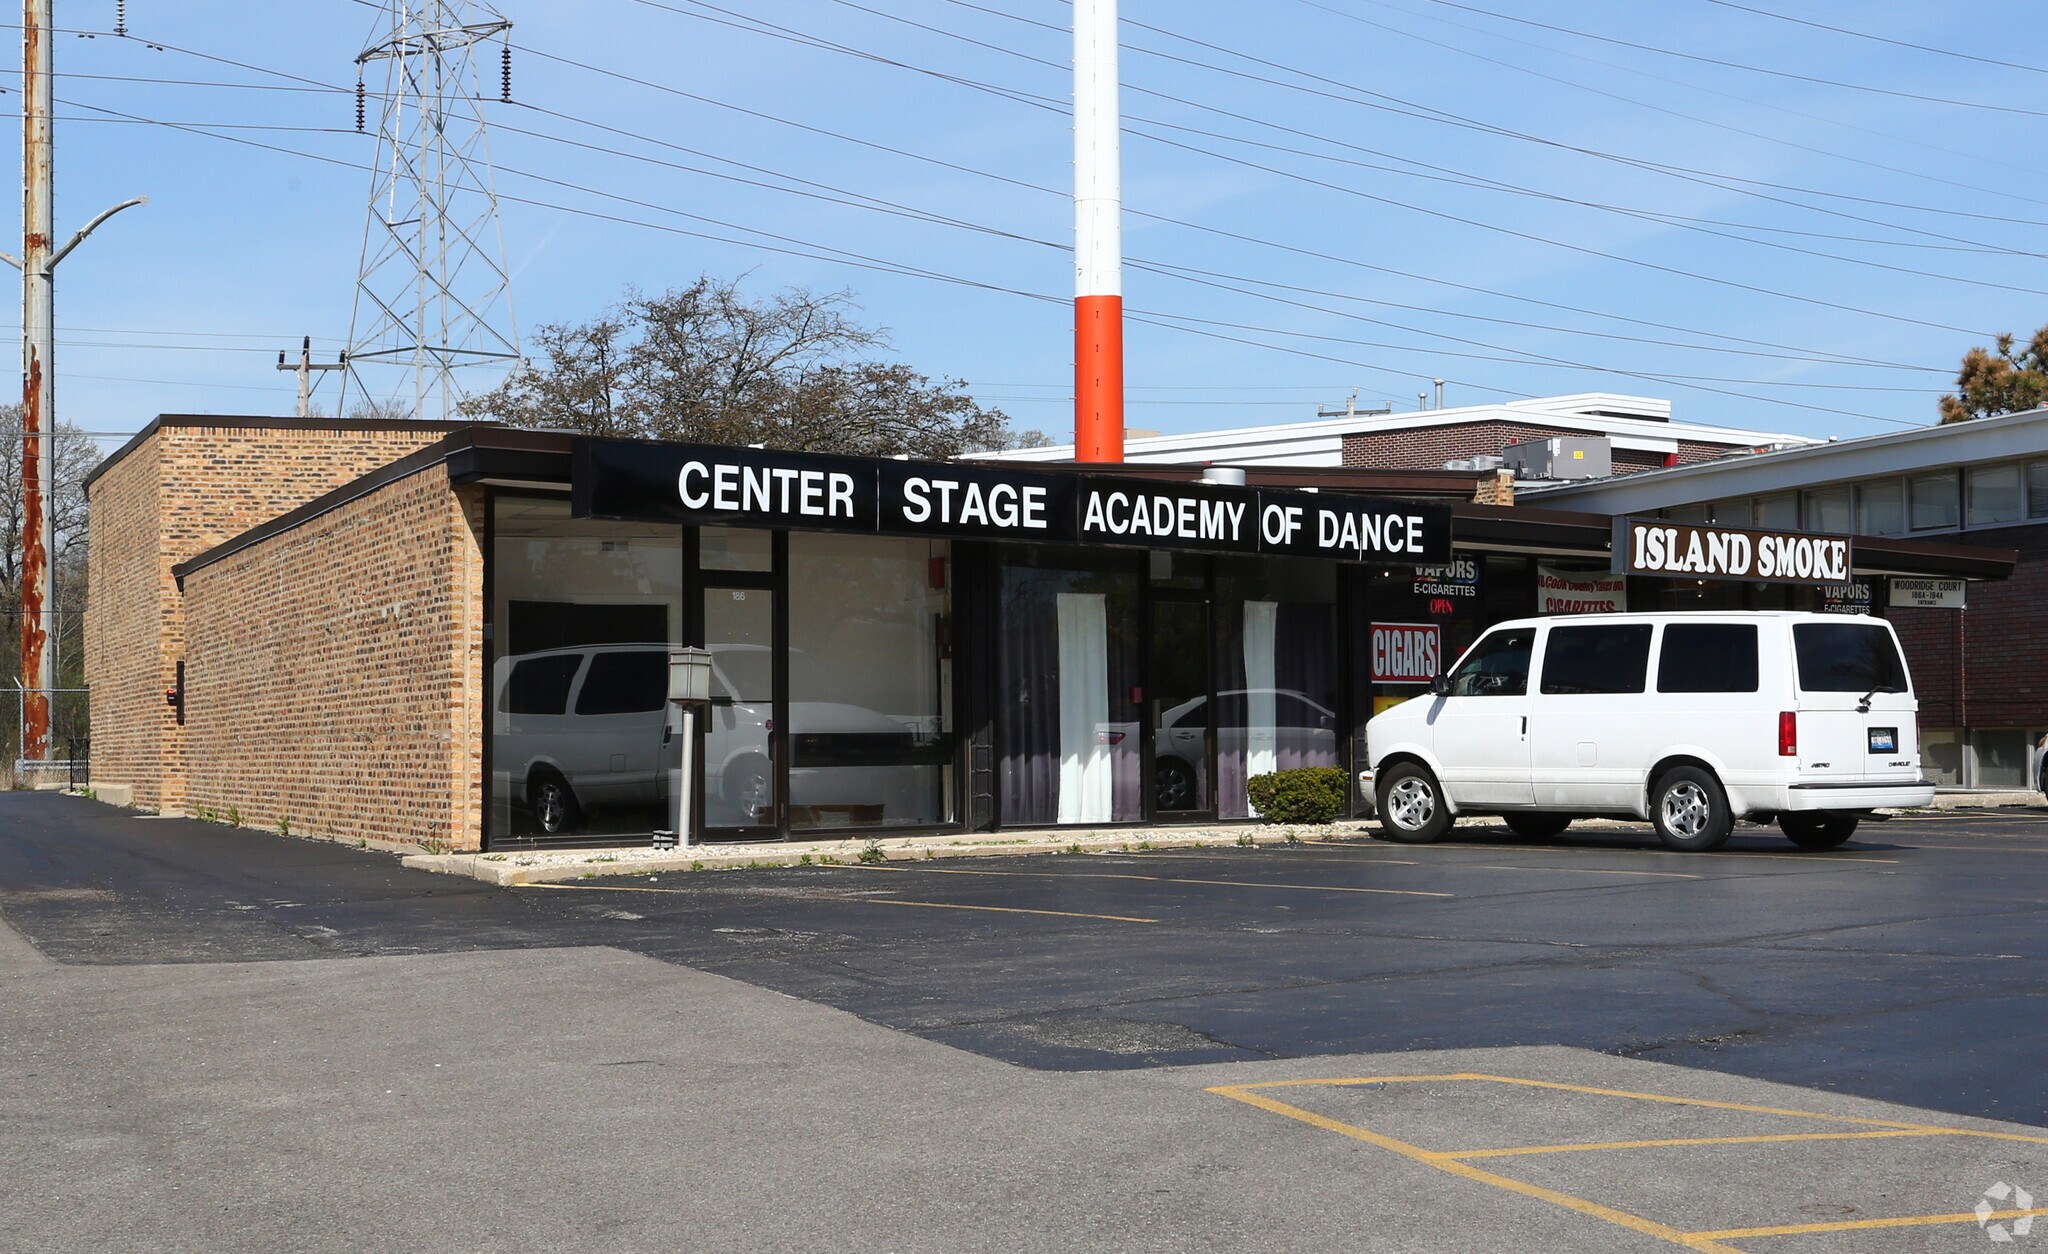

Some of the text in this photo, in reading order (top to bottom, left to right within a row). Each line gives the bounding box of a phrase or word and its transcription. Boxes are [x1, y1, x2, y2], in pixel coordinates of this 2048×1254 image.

[678, 460, 1424, 553] CENTER STAGE ACADEMY OF DANCE
[1633, 525, 1847, 581] ISLAND SMOKE
[1414, 583, 1476, 596] E-CIGARETTES
[1825, 584, 1870, 600] VAPORS
[1894, 580, 1962, 592] WOODRIDGE COURT
[732, 591, 745, 600] 186
[1429, 599, 1454, 614] OPEN
[1546, 597, 1616, 613] CIGARETTES
[1372, 629, 1437, 678] CIGARS
